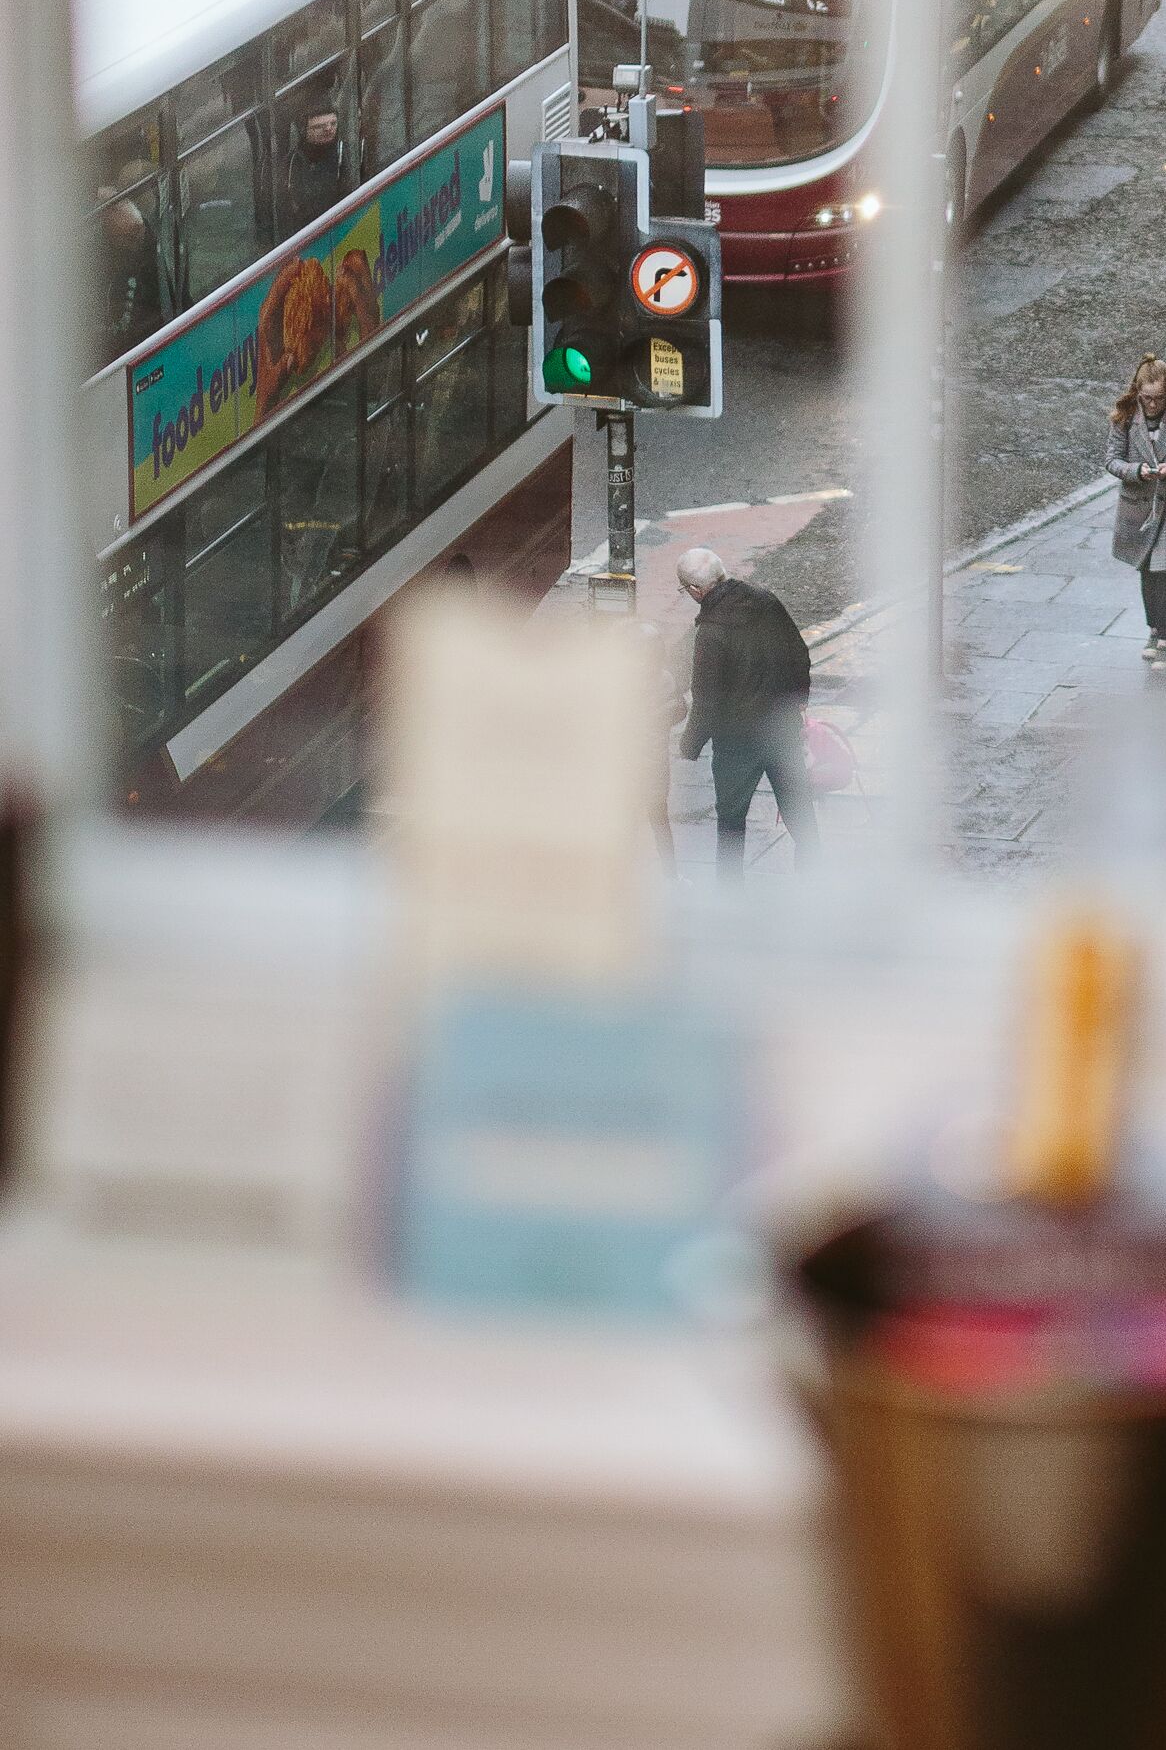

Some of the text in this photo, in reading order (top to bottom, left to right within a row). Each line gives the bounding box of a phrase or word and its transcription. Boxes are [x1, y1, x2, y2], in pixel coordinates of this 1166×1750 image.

[654, 354, 679, 365] buses
[654, 367, 680, 377] cycles
[151, 364, 205, 480] food
[209, 328, 260, 416] envy
